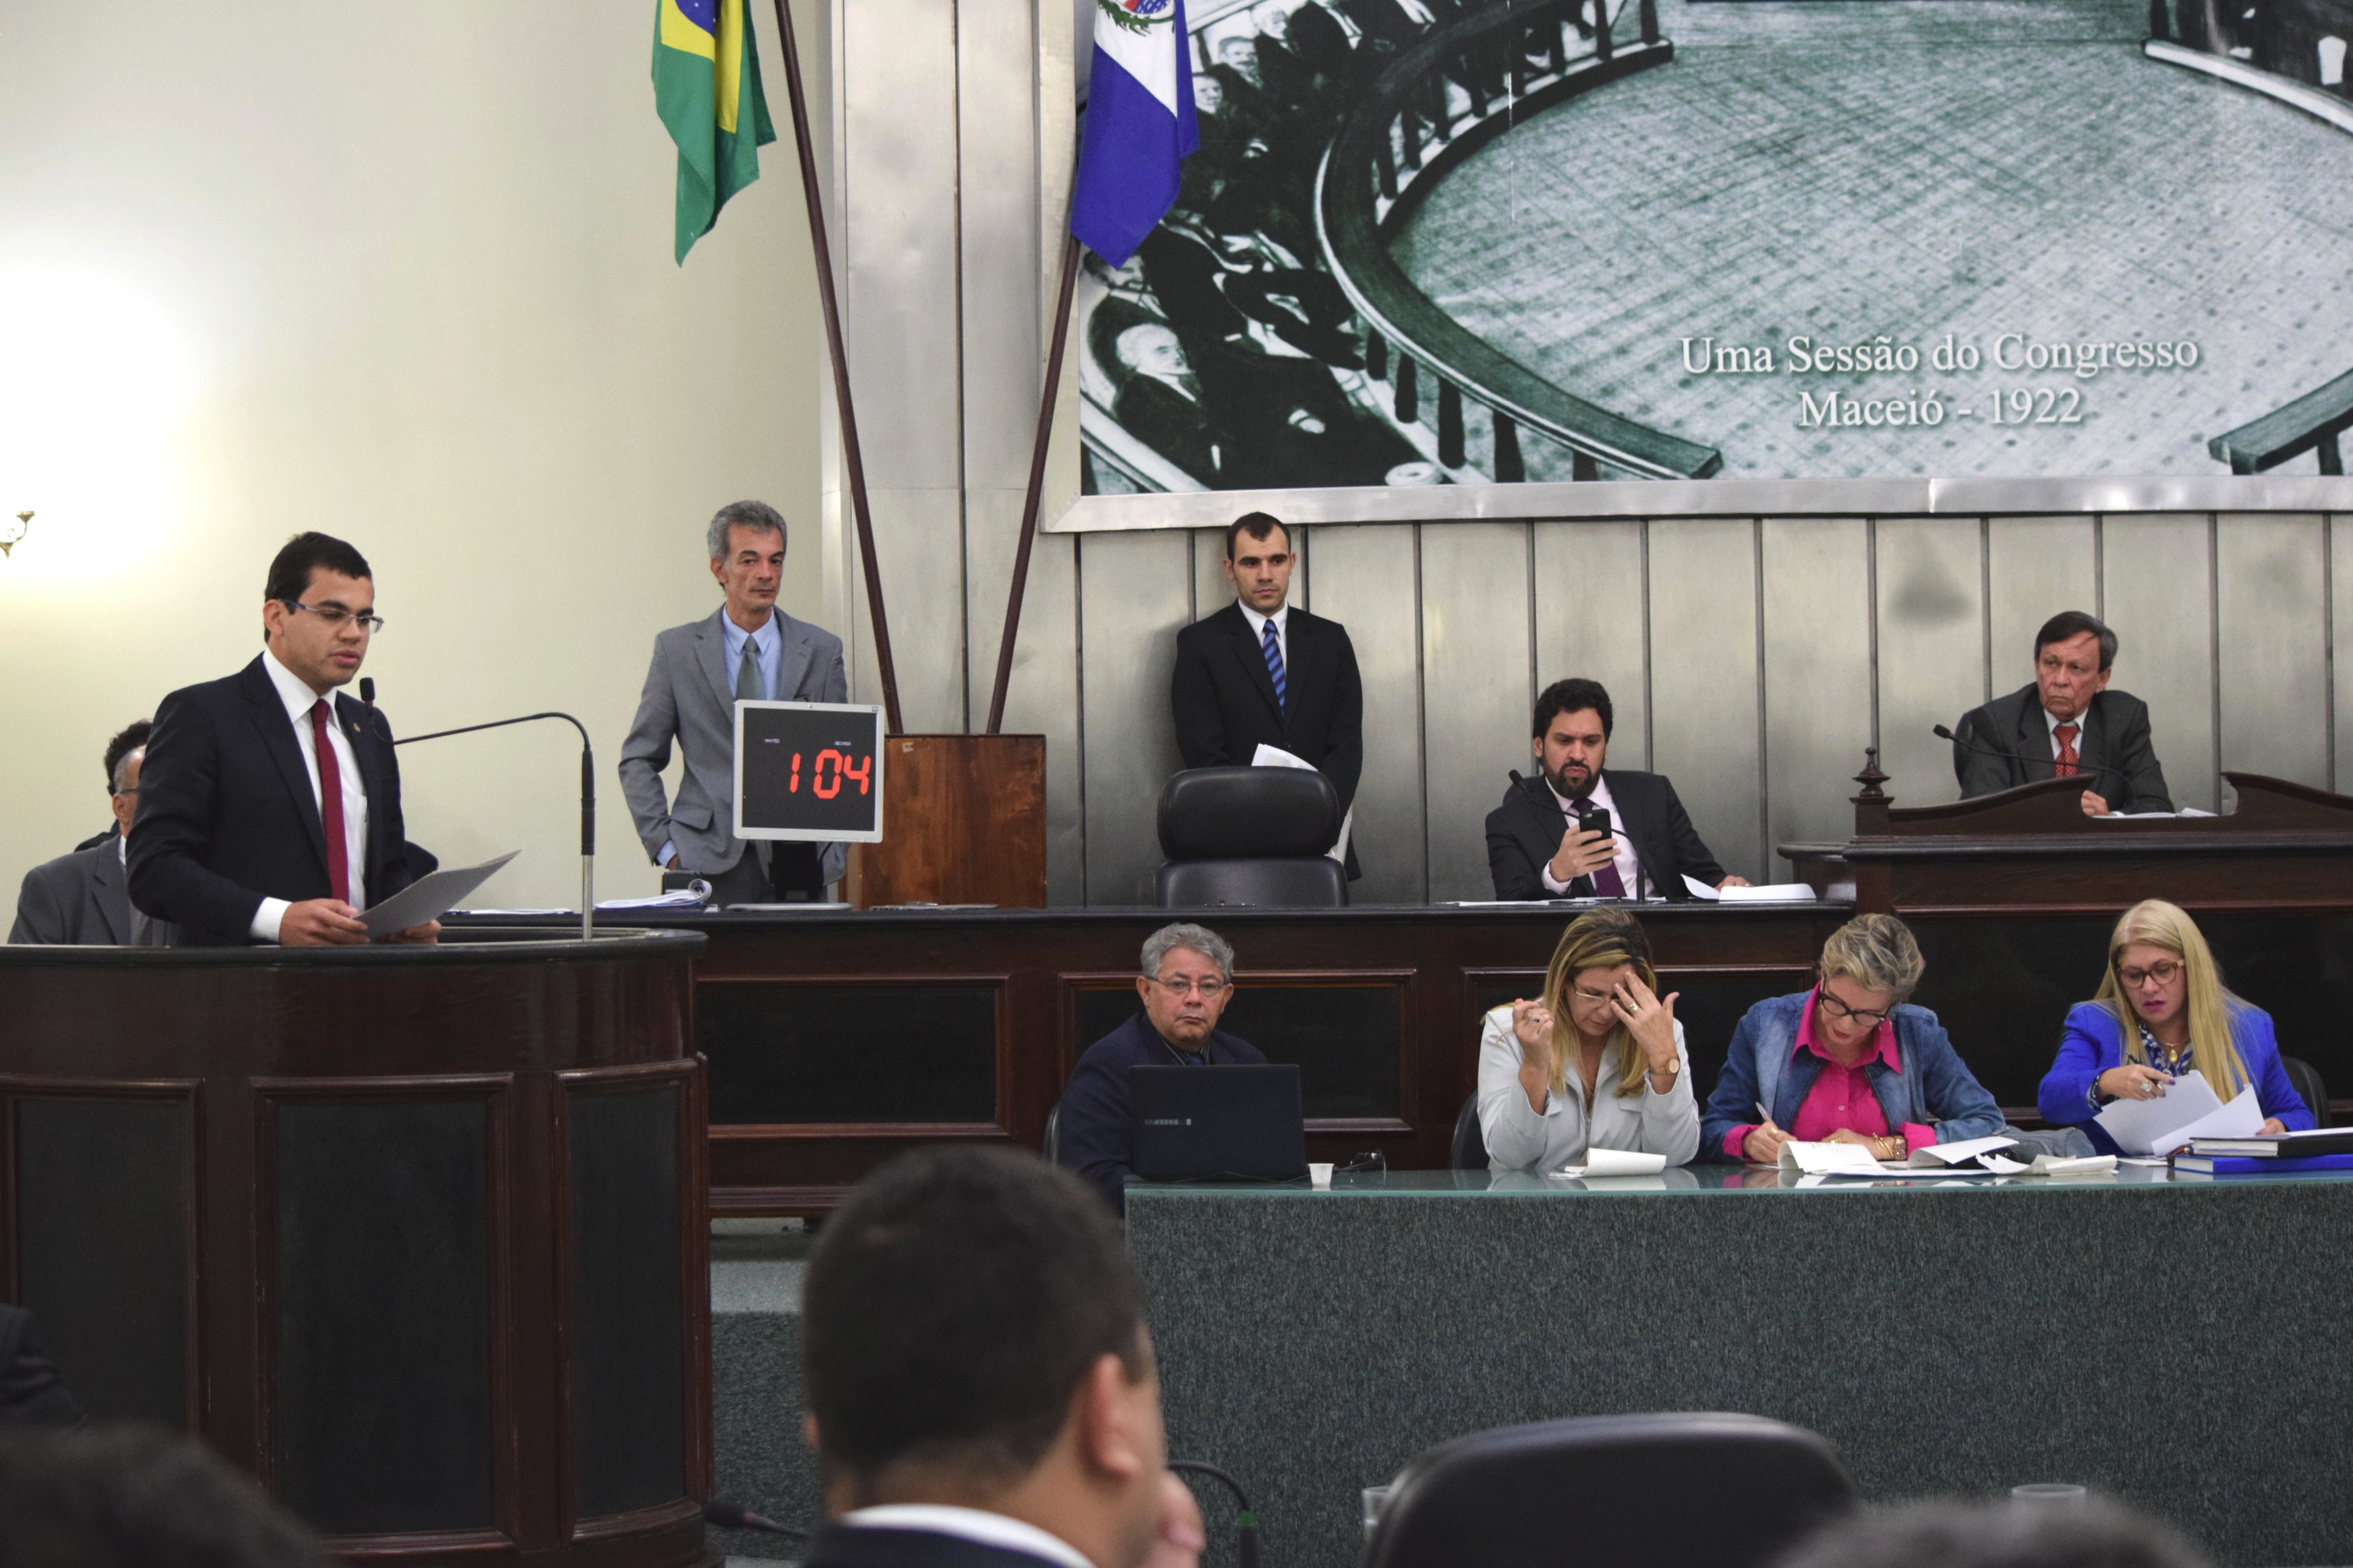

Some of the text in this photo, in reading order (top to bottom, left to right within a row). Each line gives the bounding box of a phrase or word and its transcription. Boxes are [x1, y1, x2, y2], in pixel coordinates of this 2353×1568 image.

[1679, 333, 2199, 378] Uma Sessão do Congresso
[1798, 389, 1944, 426] Maceió
[1989, 388, 2082, 424] 1922
